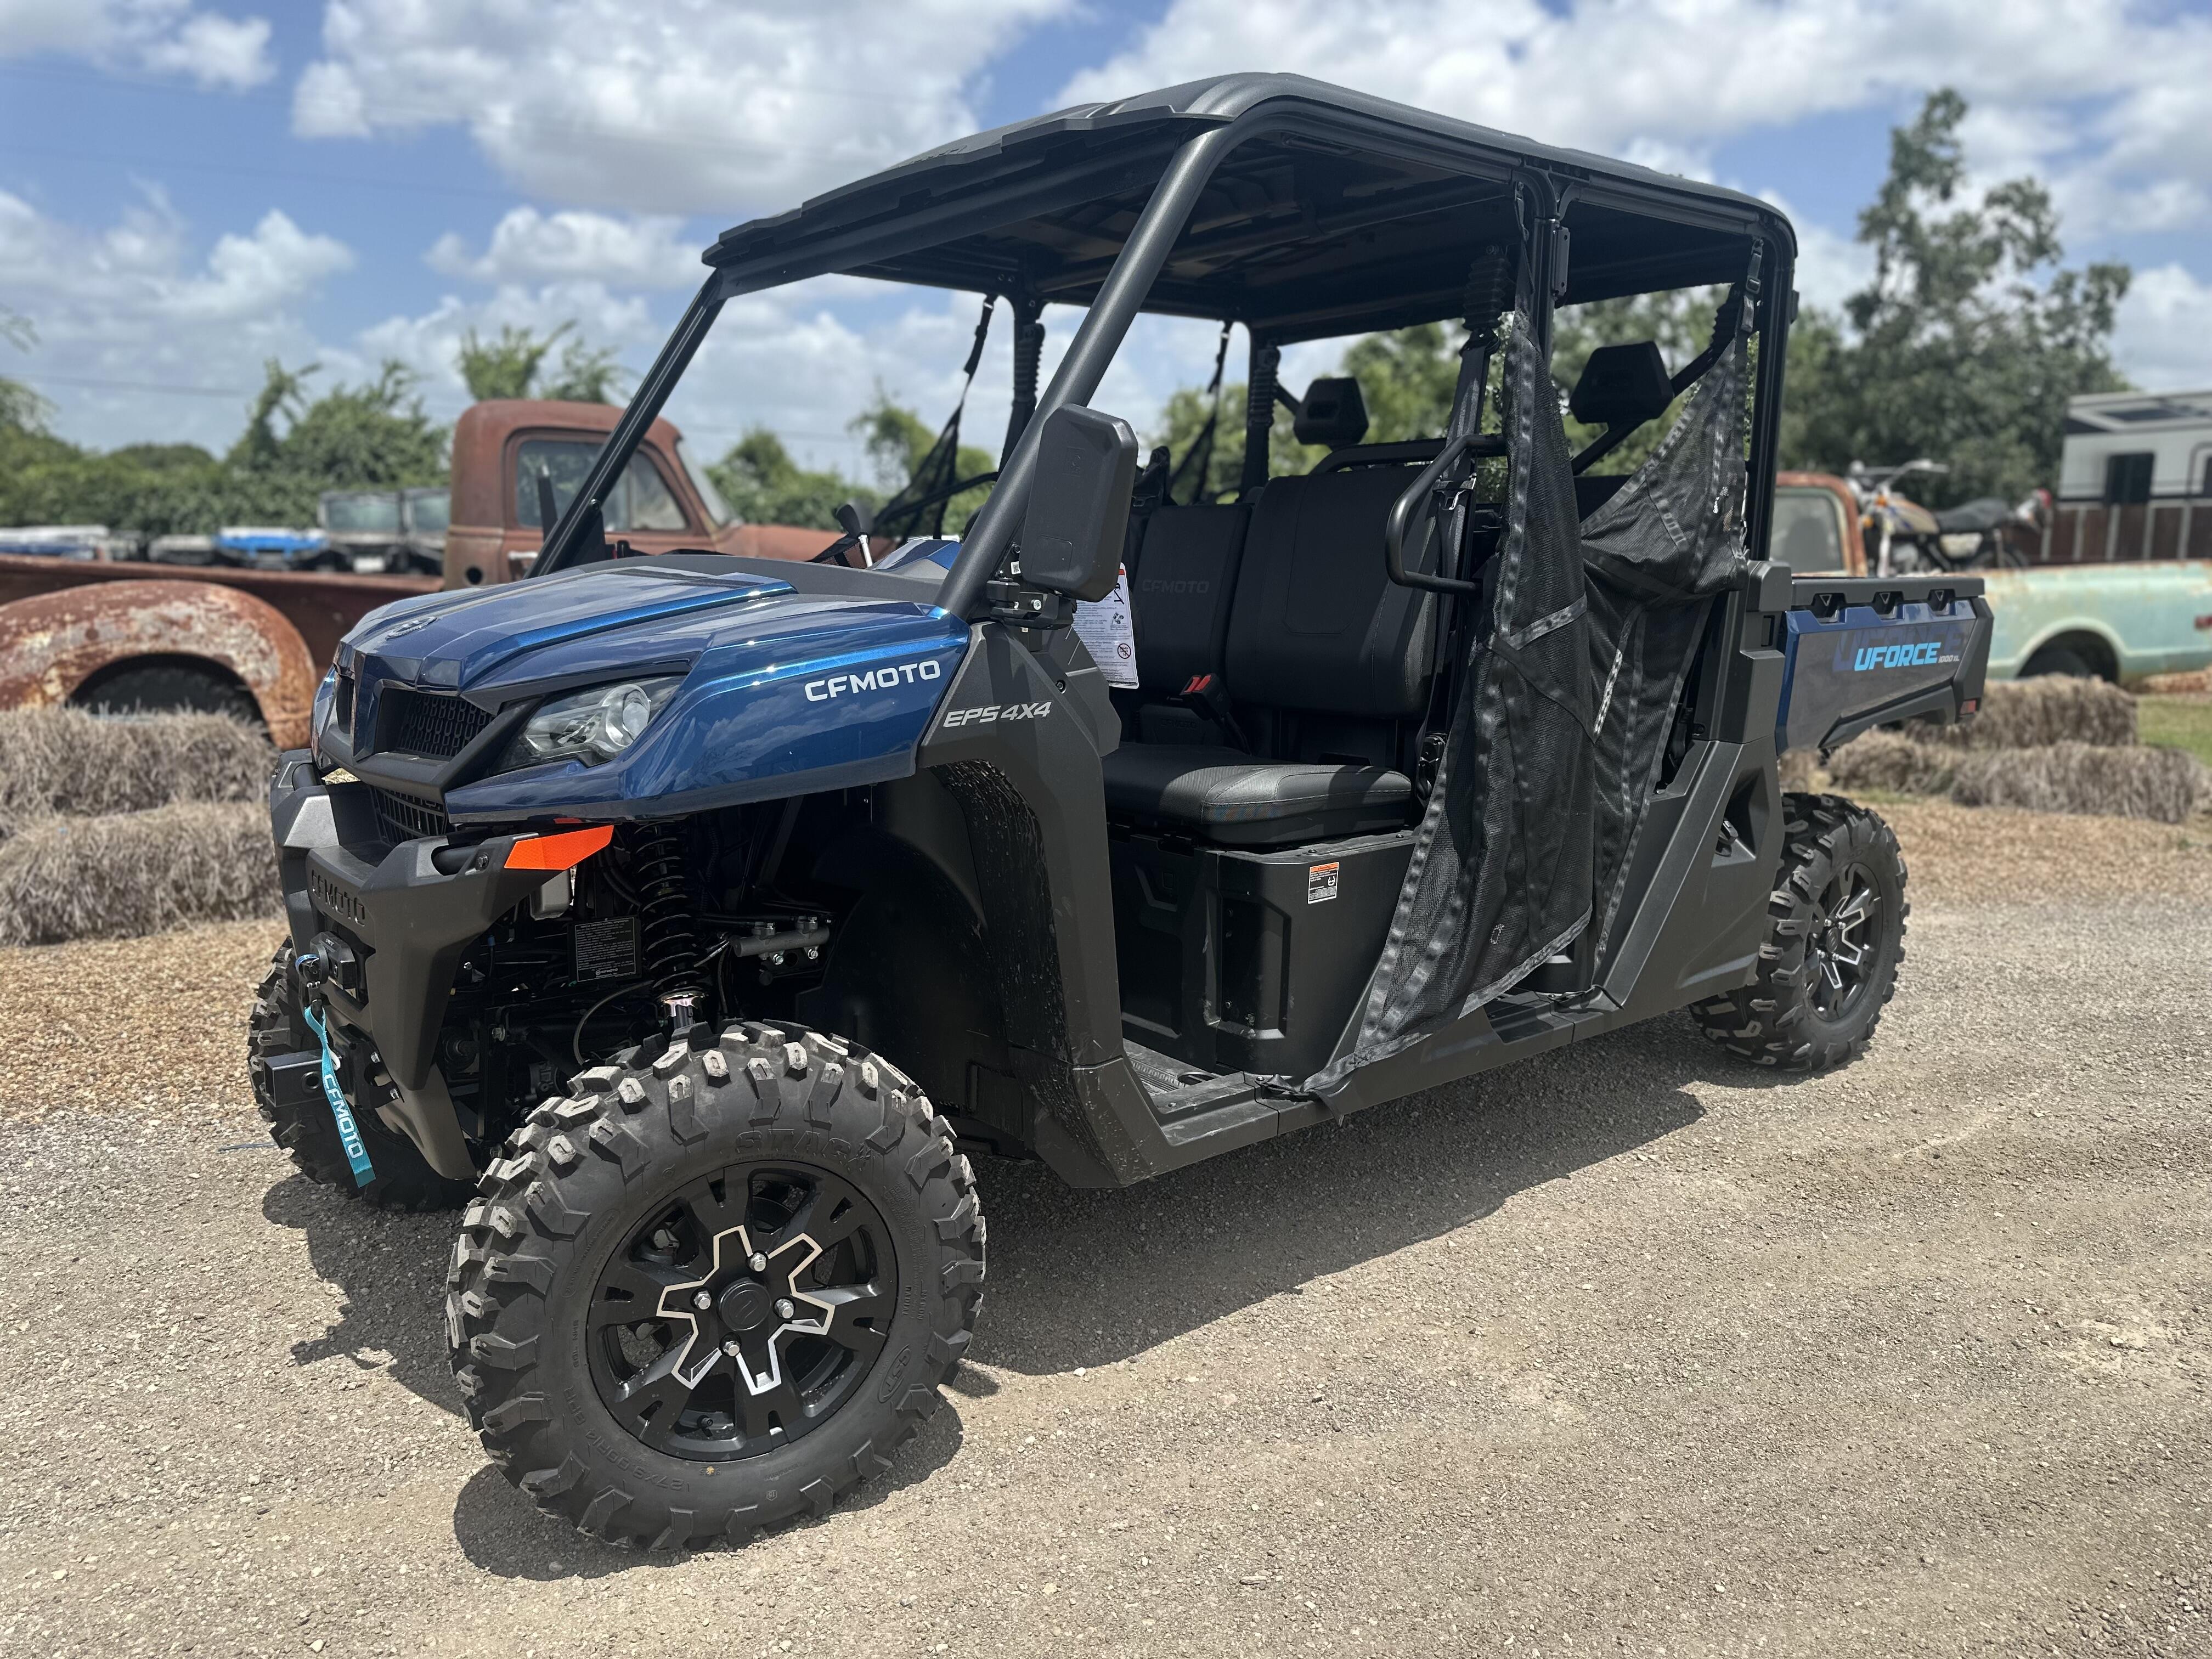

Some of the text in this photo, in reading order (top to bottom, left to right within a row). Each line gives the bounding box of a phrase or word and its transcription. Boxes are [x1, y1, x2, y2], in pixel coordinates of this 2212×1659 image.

[1142, 579, 1210, 593] CFMOTO
[1854, 642, 1942, 672] UFORCE
[1938, 655, 1954, 663] 1000
[805, 659, 941, 702] CFMOTO
[311, 870, 365, 927] CFMOTO
[324, 1074, 364, 1159] CFMOTO
